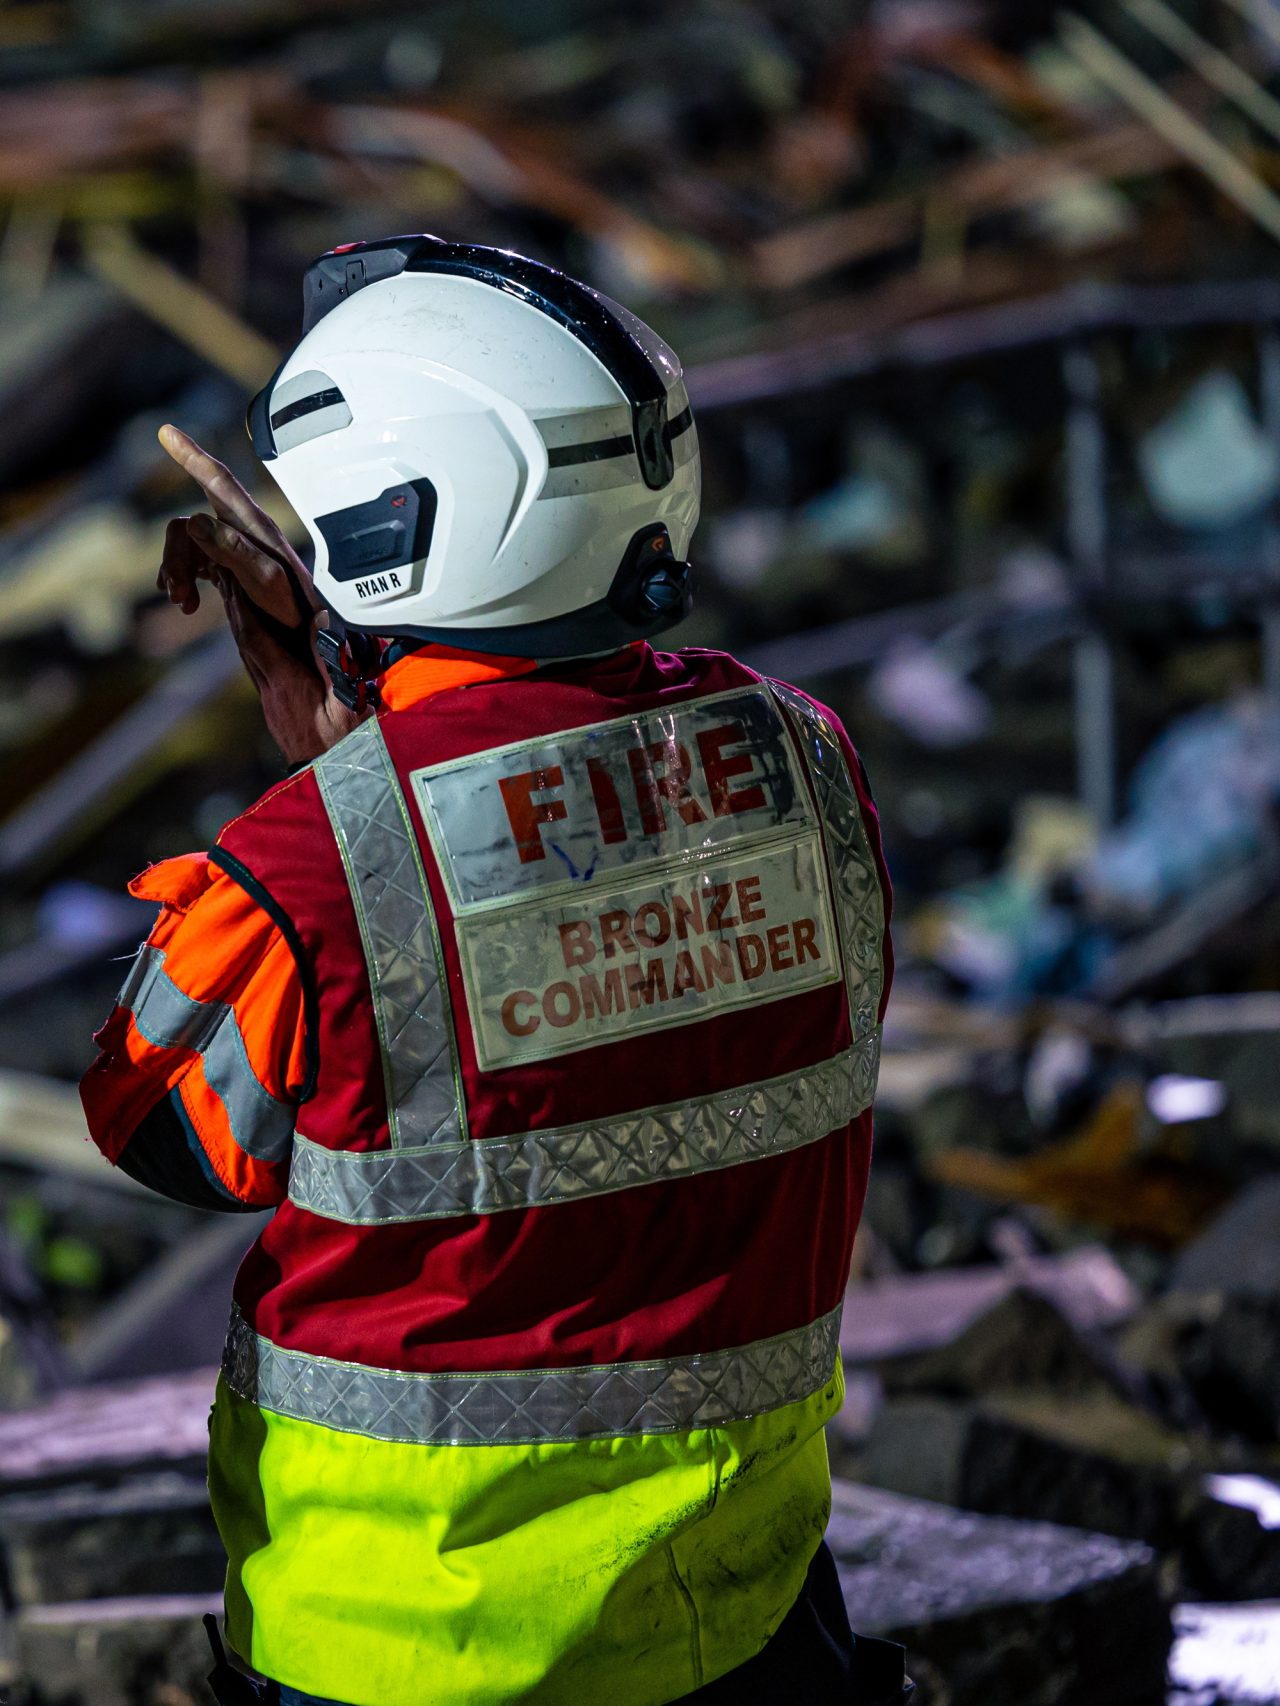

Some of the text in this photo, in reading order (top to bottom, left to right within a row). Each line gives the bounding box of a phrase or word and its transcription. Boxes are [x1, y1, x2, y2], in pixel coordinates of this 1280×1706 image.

[355, 572, 402, 598] RYAN R
[498, 724, 767, 864] FIRE
[559, 876, 766, 969] BRONZE
[501, 918, 821, 1037] COMMANDER
